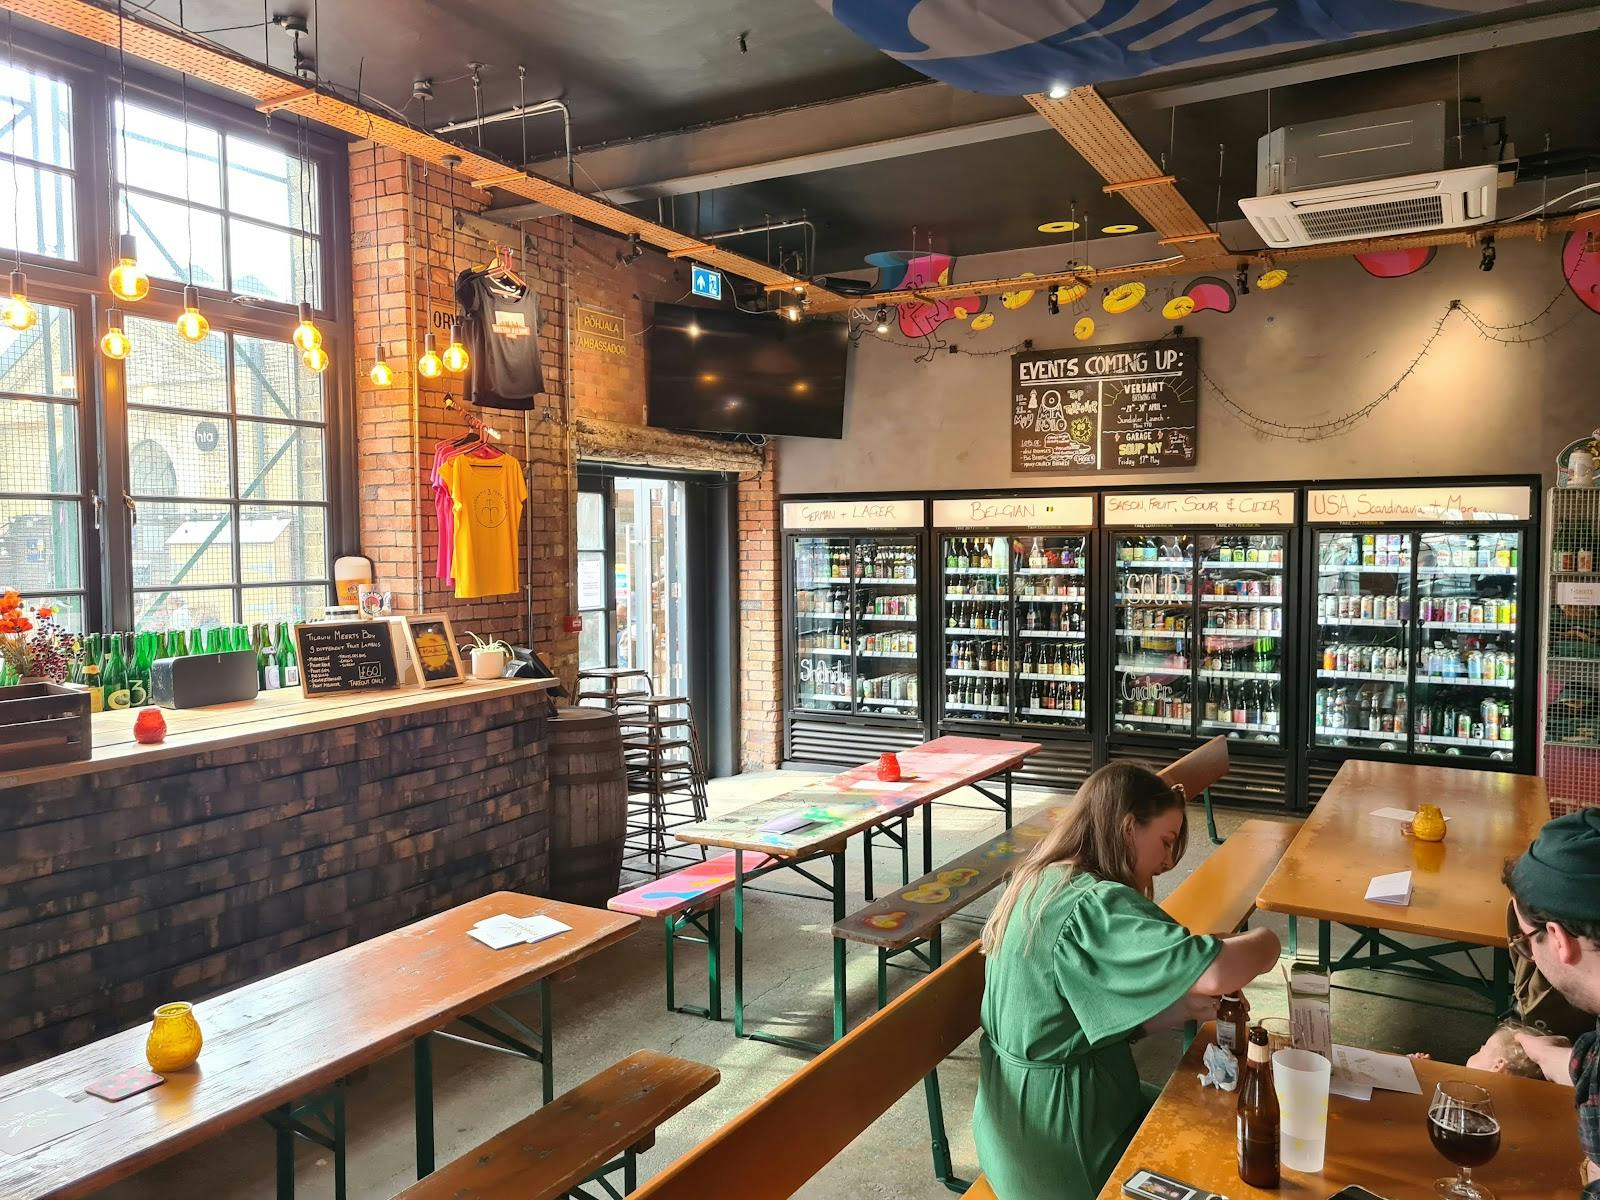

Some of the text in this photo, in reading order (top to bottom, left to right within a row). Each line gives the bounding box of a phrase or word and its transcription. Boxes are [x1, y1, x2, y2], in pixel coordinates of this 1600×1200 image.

[576, 337, 626, 355] AMBASSADOR
[1020, 349, 1184, 380] EVENTS COMING UP:
[1123, 381, 1165, 394] VERDANT
[1126, 431, 1153, 441] GARAGE
[1118, 457, 1135, 466] Friday
[800, 504, 836, 522] GERMAN
[852, 503, 896, 519] LAGER
[970, 501, 1036, 520] BELGIAN
[1182, 496, 1219, 513] SOUR
[1238, 497, 1282, 515] CIDER
[1357, 493, 1425, 515] Scandinavia
[1126, 573, 1183, 606] SOUR
[305, 632, 331, 641] TILQUIN
[360, 665, 379, 678] £60
[1121, 671, 1173, 703] Cider
